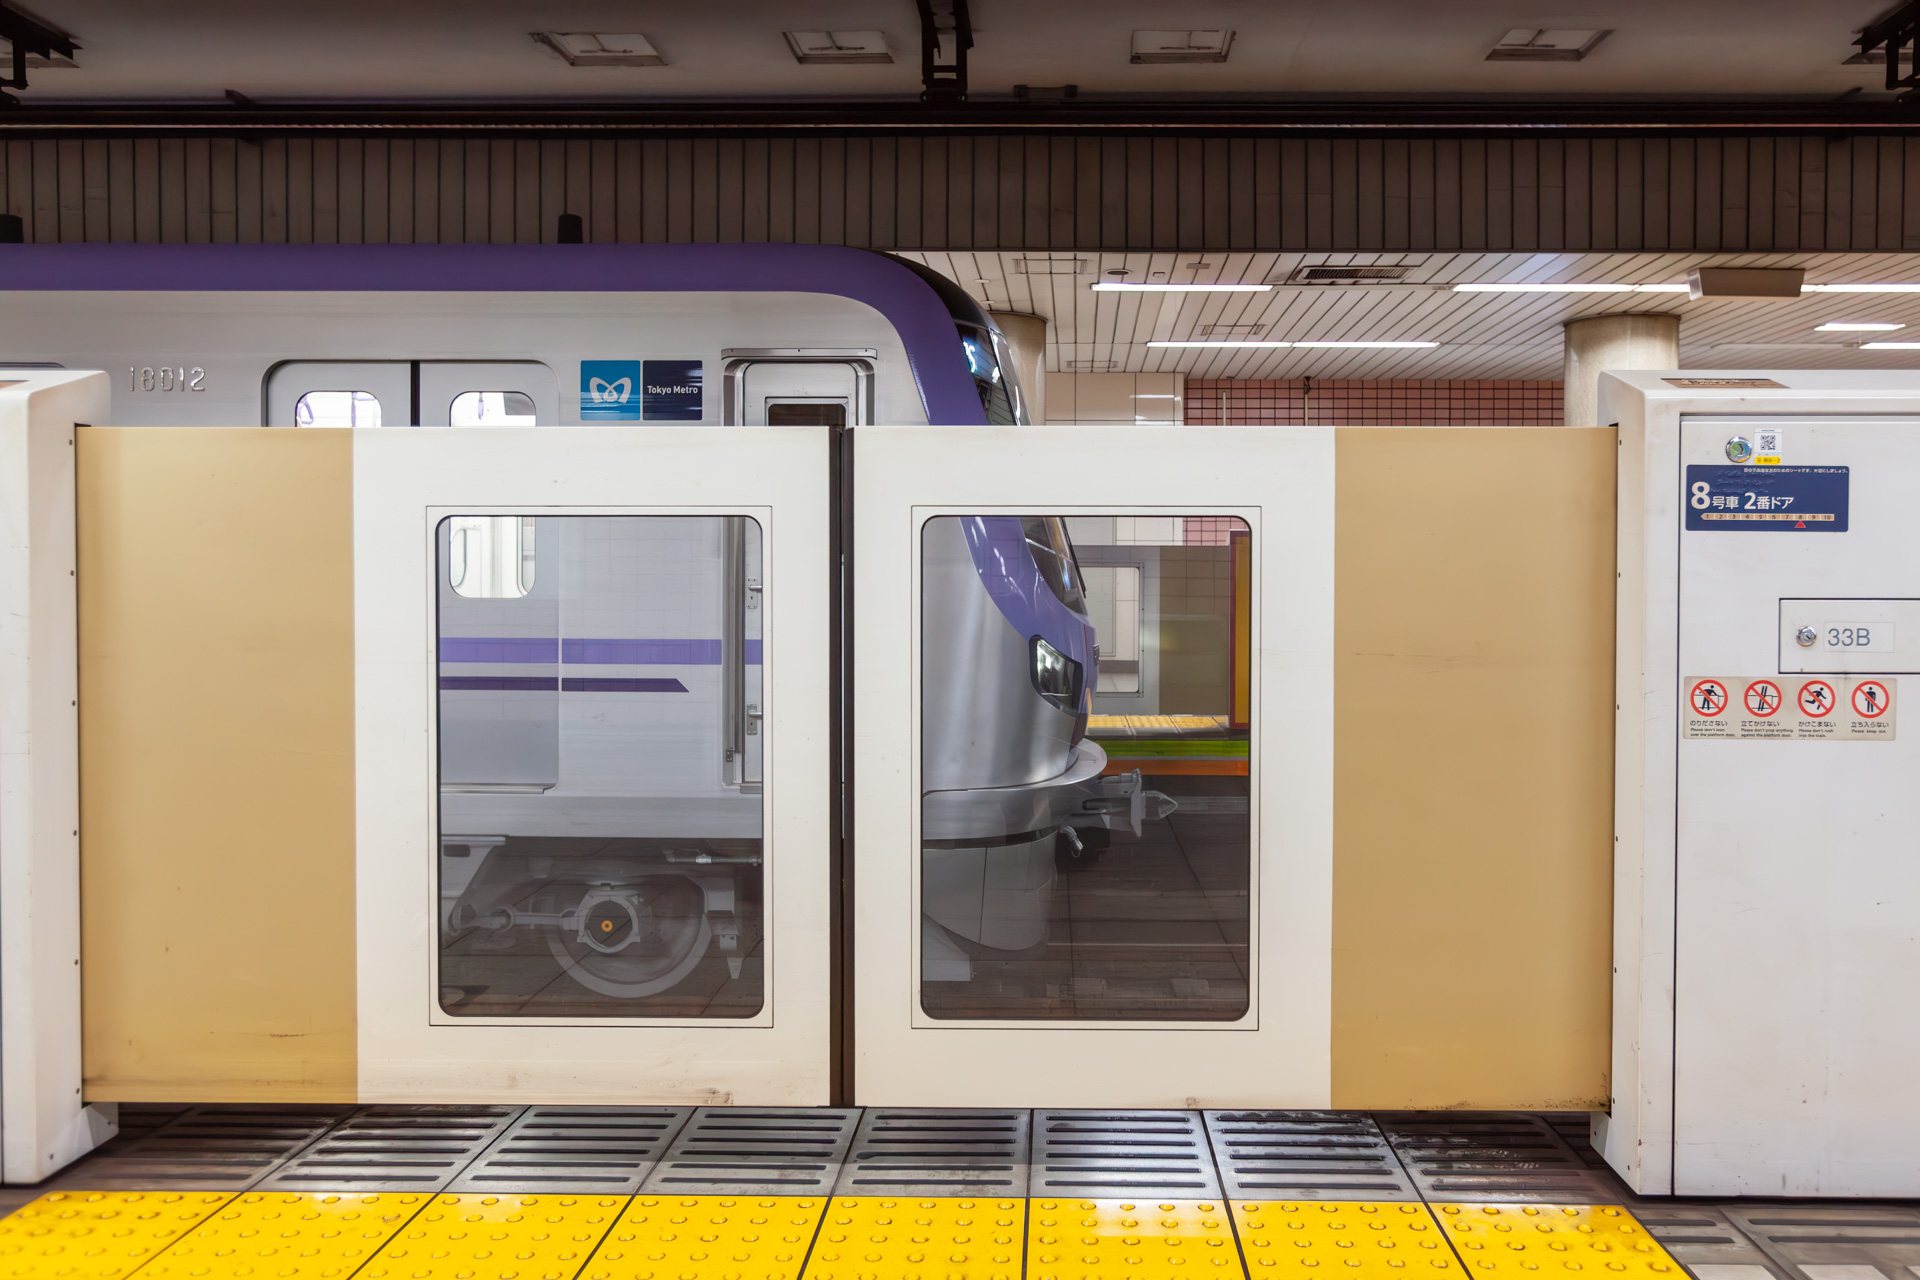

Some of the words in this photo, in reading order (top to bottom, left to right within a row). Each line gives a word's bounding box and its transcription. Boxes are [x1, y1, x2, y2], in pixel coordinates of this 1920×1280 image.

[130, 367, 205, 392] 18012
[647, 385, 671, 395] Tokyo
[673, 386, 698, 394] Metro
[1690, 481, 1739, 510] 8号車
[1744, 492, 1794, 510] 2番ドア
[1827, 628, 1871, 646] 33B
